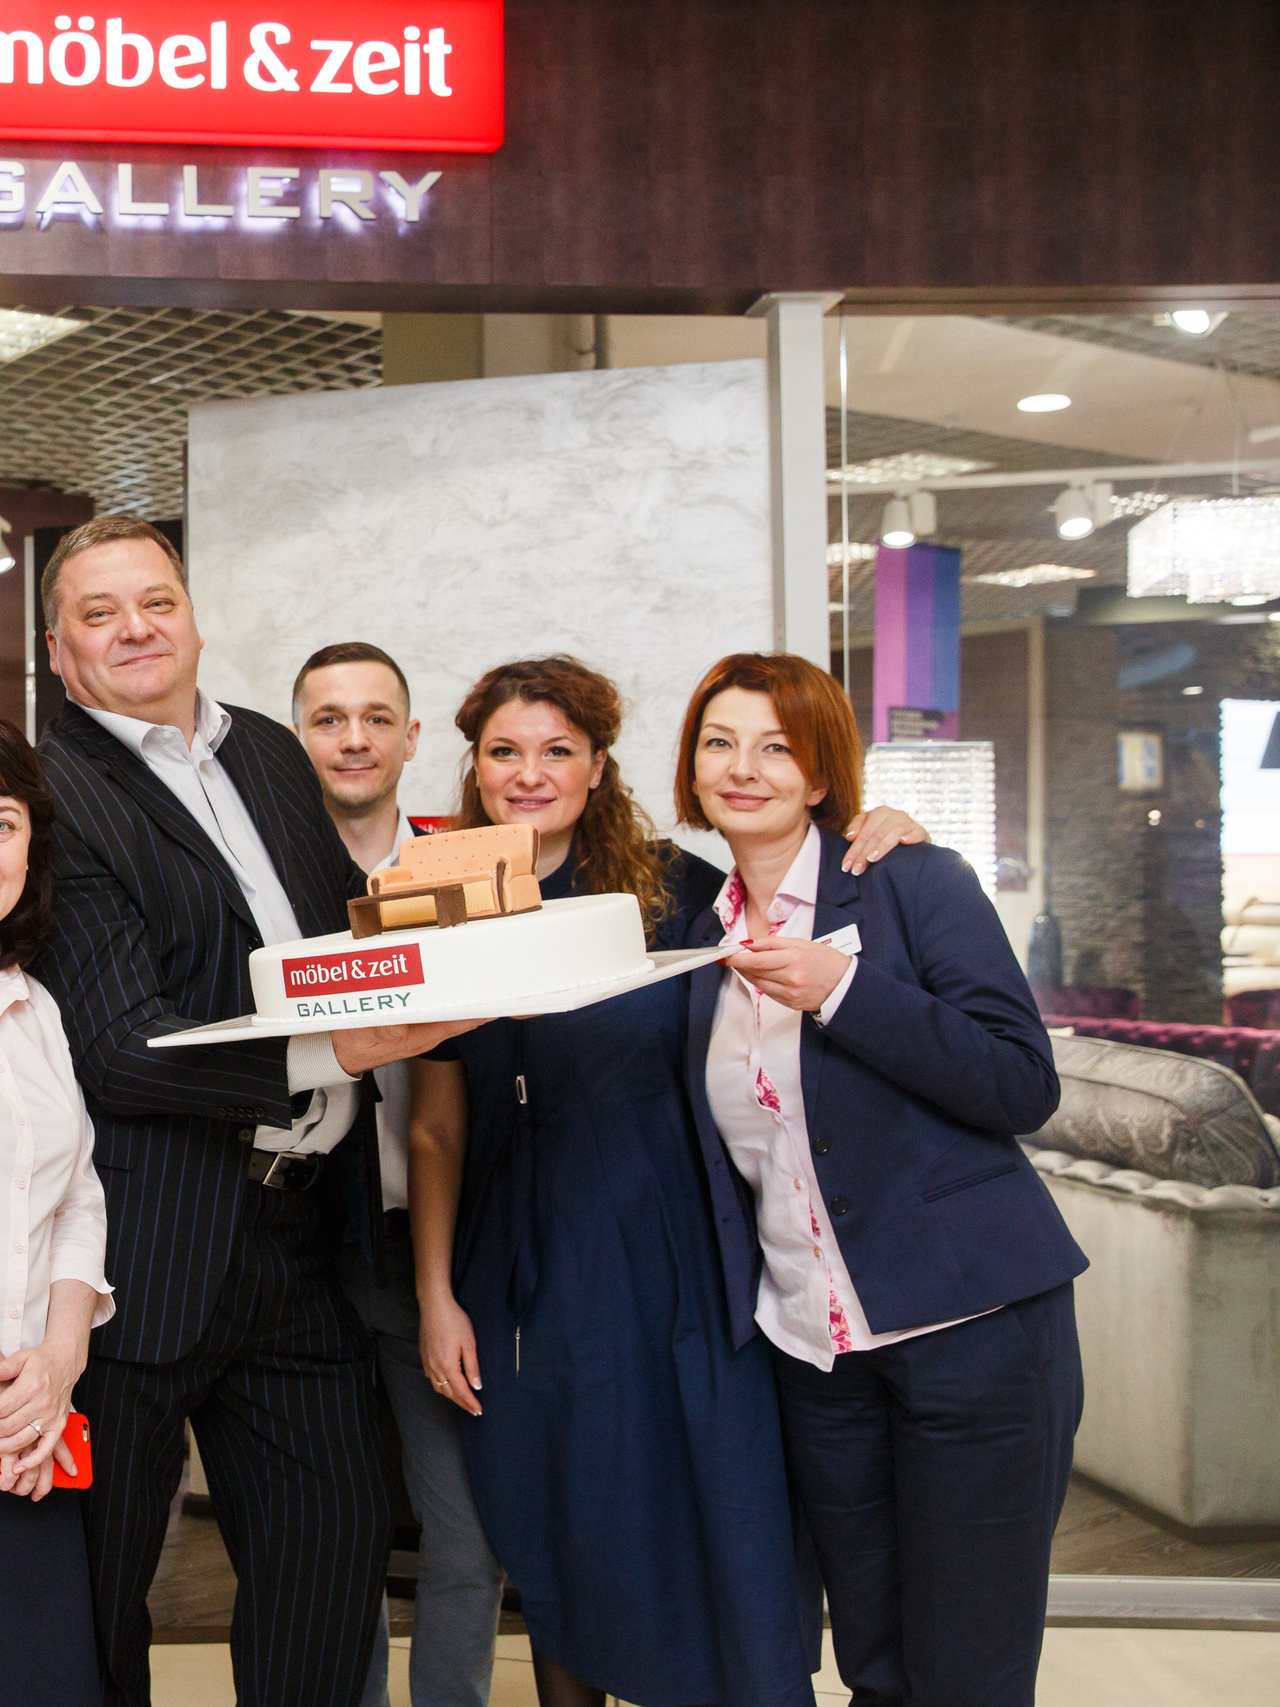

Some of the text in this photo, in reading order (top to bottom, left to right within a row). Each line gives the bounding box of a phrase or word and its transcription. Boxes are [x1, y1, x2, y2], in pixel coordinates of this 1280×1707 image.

[242, 22, 301, 92] &
[310, 26, 453, 97] zeit
[290, 954, 408, 985] möbel & zeit
[297, 993, 411, 1017] GALLERY
